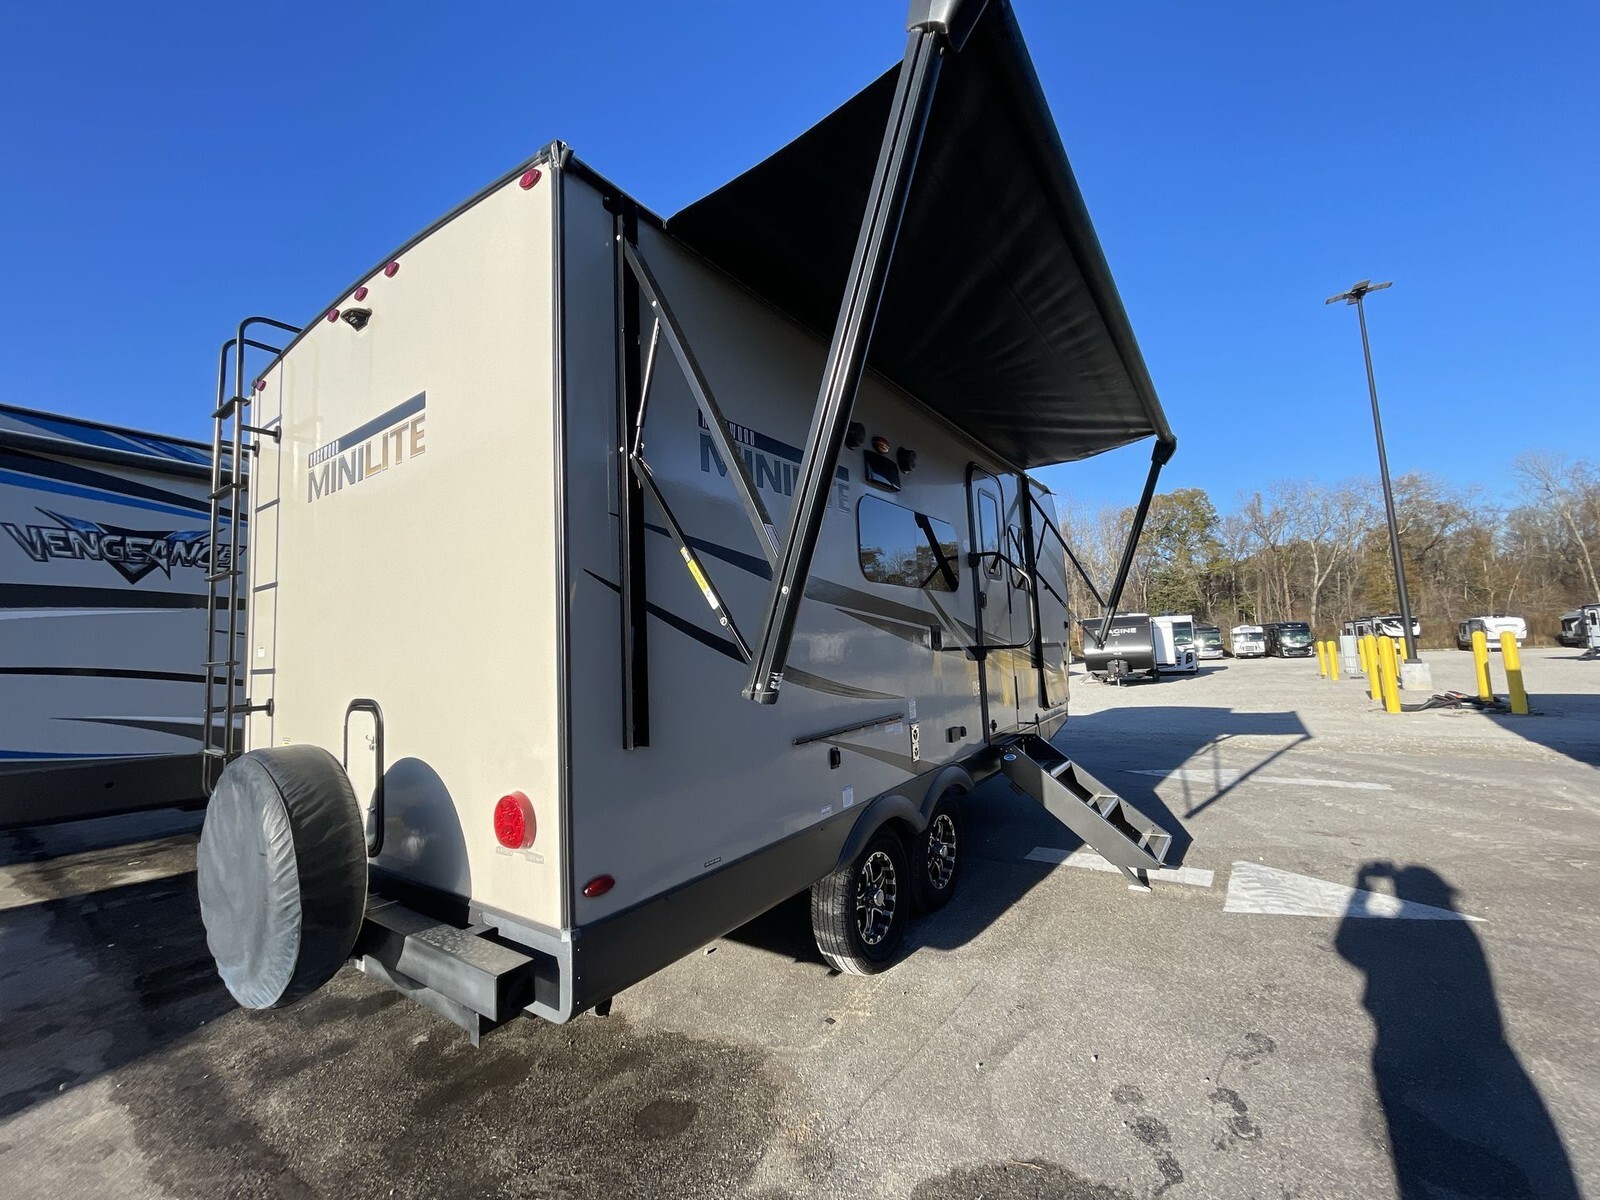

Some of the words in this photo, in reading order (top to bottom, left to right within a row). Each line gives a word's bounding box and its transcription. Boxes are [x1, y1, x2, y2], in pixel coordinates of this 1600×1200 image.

[308, 412, 426, 503] MINILITE
[700, 431, 850, 514] MINIE
[1, 521, 248, 577] VENGEANCE
[1094, 627, 1137, 636] IAGINE
